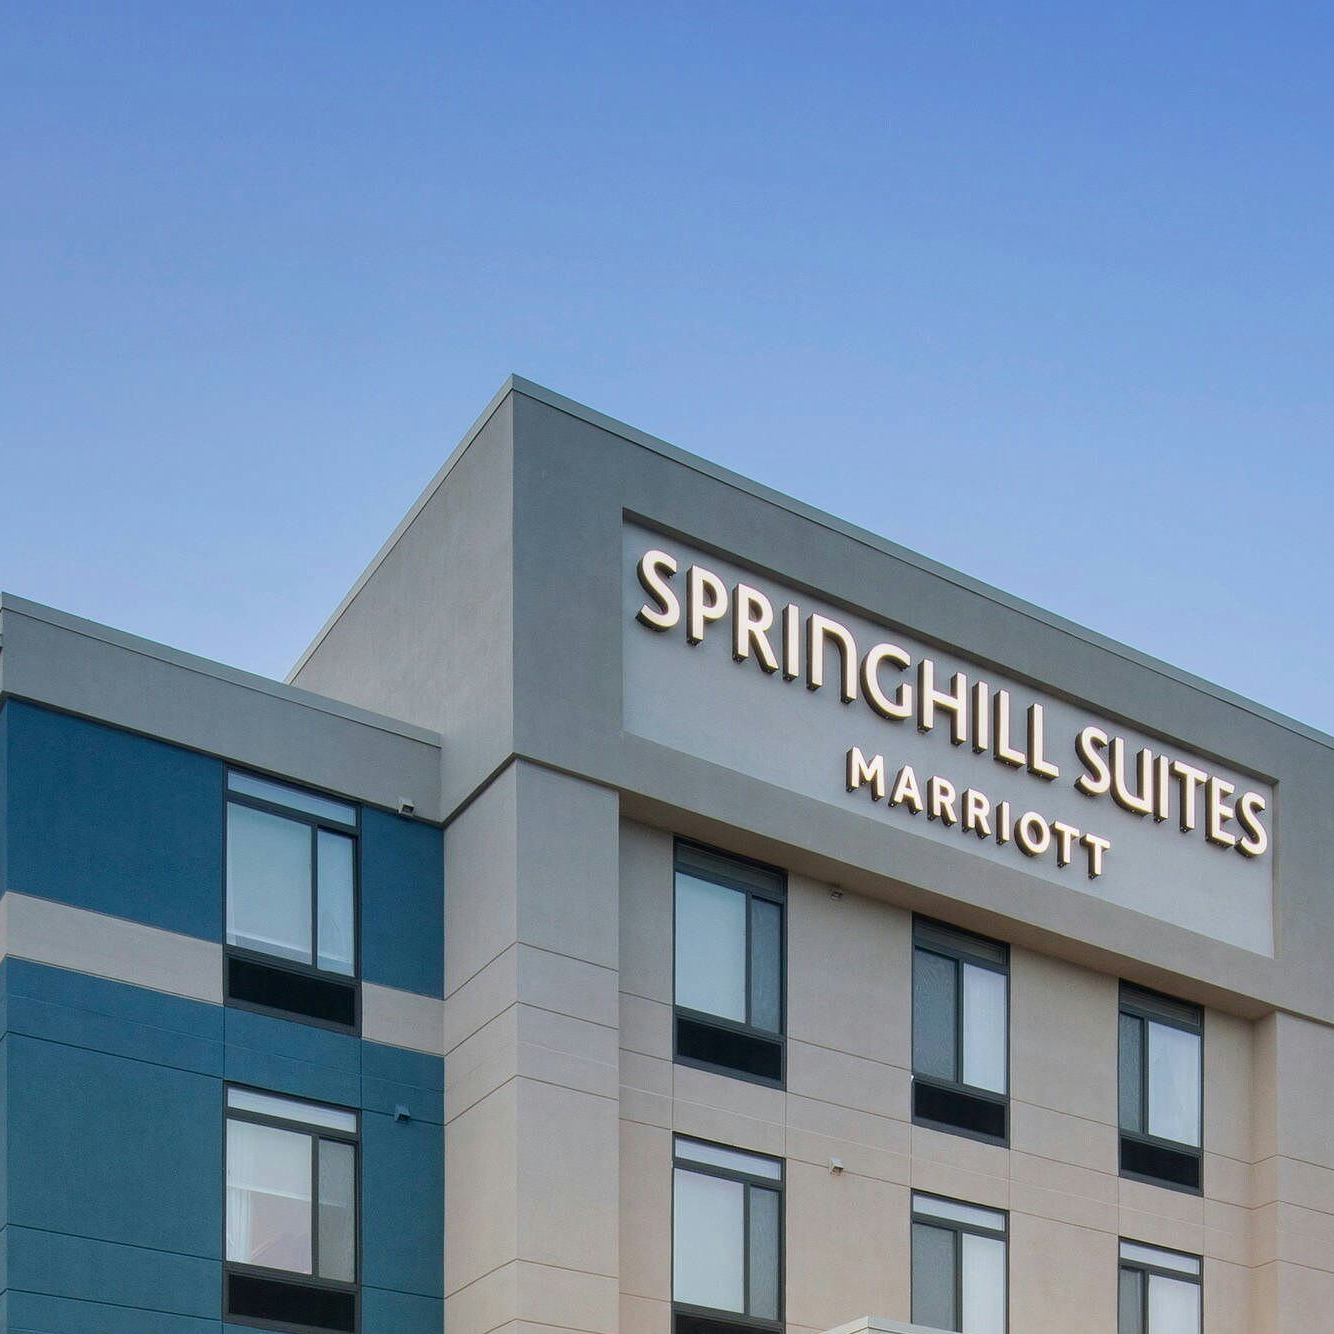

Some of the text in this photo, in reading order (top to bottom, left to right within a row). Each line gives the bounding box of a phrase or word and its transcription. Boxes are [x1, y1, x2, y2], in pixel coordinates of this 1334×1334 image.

[636, 549, 1269, 858] SPRINGHILL SUITES
[846, 746, 1111, 878] MARRIOTT
